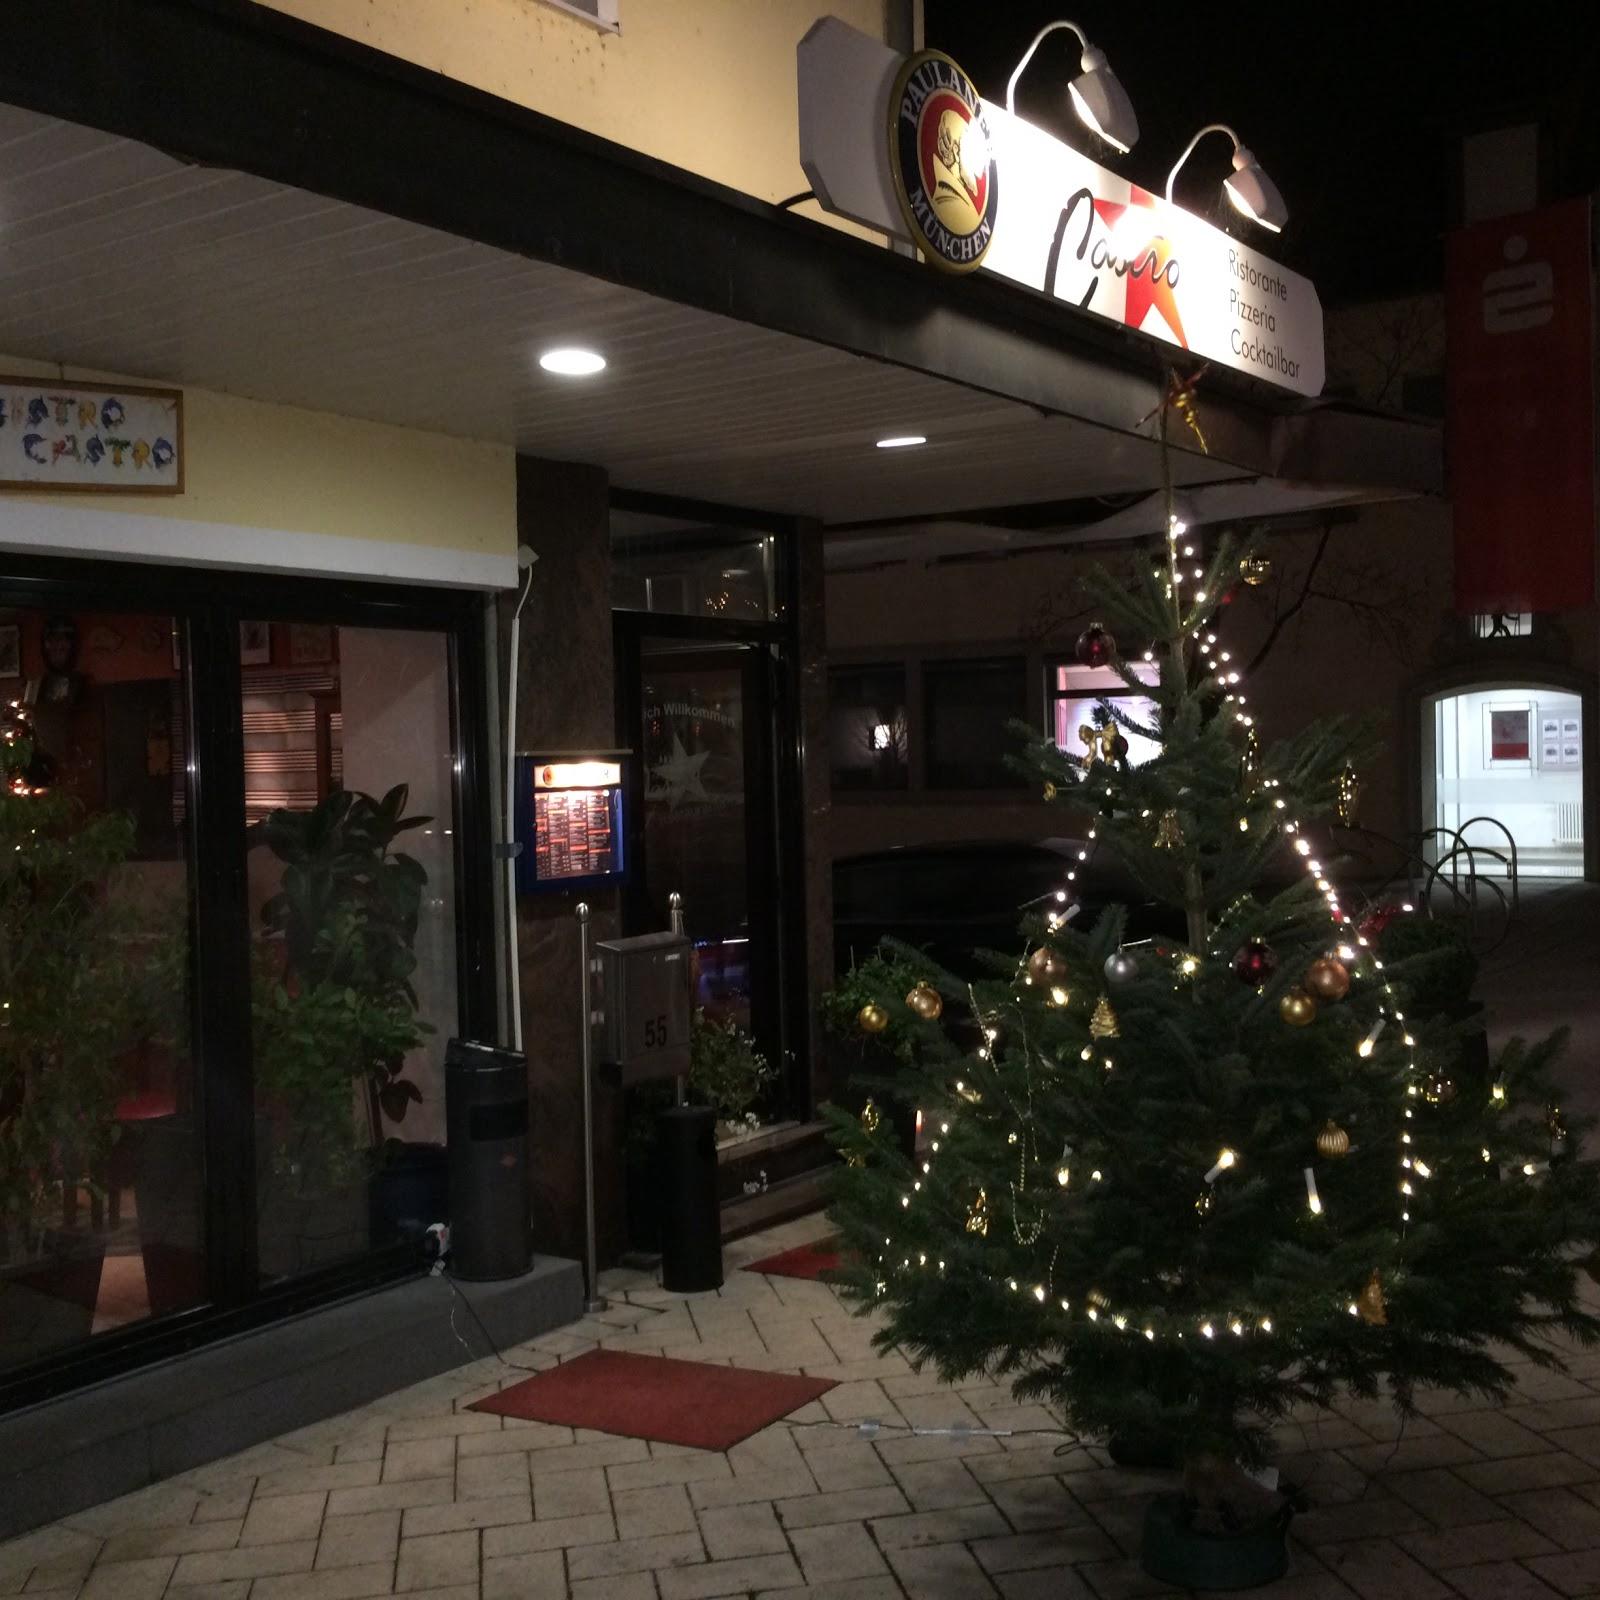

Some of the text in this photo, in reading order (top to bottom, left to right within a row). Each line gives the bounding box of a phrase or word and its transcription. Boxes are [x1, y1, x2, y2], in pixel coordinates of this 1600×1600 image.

[902, 61, 990, 140] PAULAN
[1228, 248, 1287, 301] Ristorante
[1230, 288, 1276, 332] Pizzeria
[1231, 328, 1300, 378] Cocktailbar
[22, 433, 176, 469] CASTRO
[663, 703, 735, 728] Willkommen
[644, 1015, 667, 1047] 55
